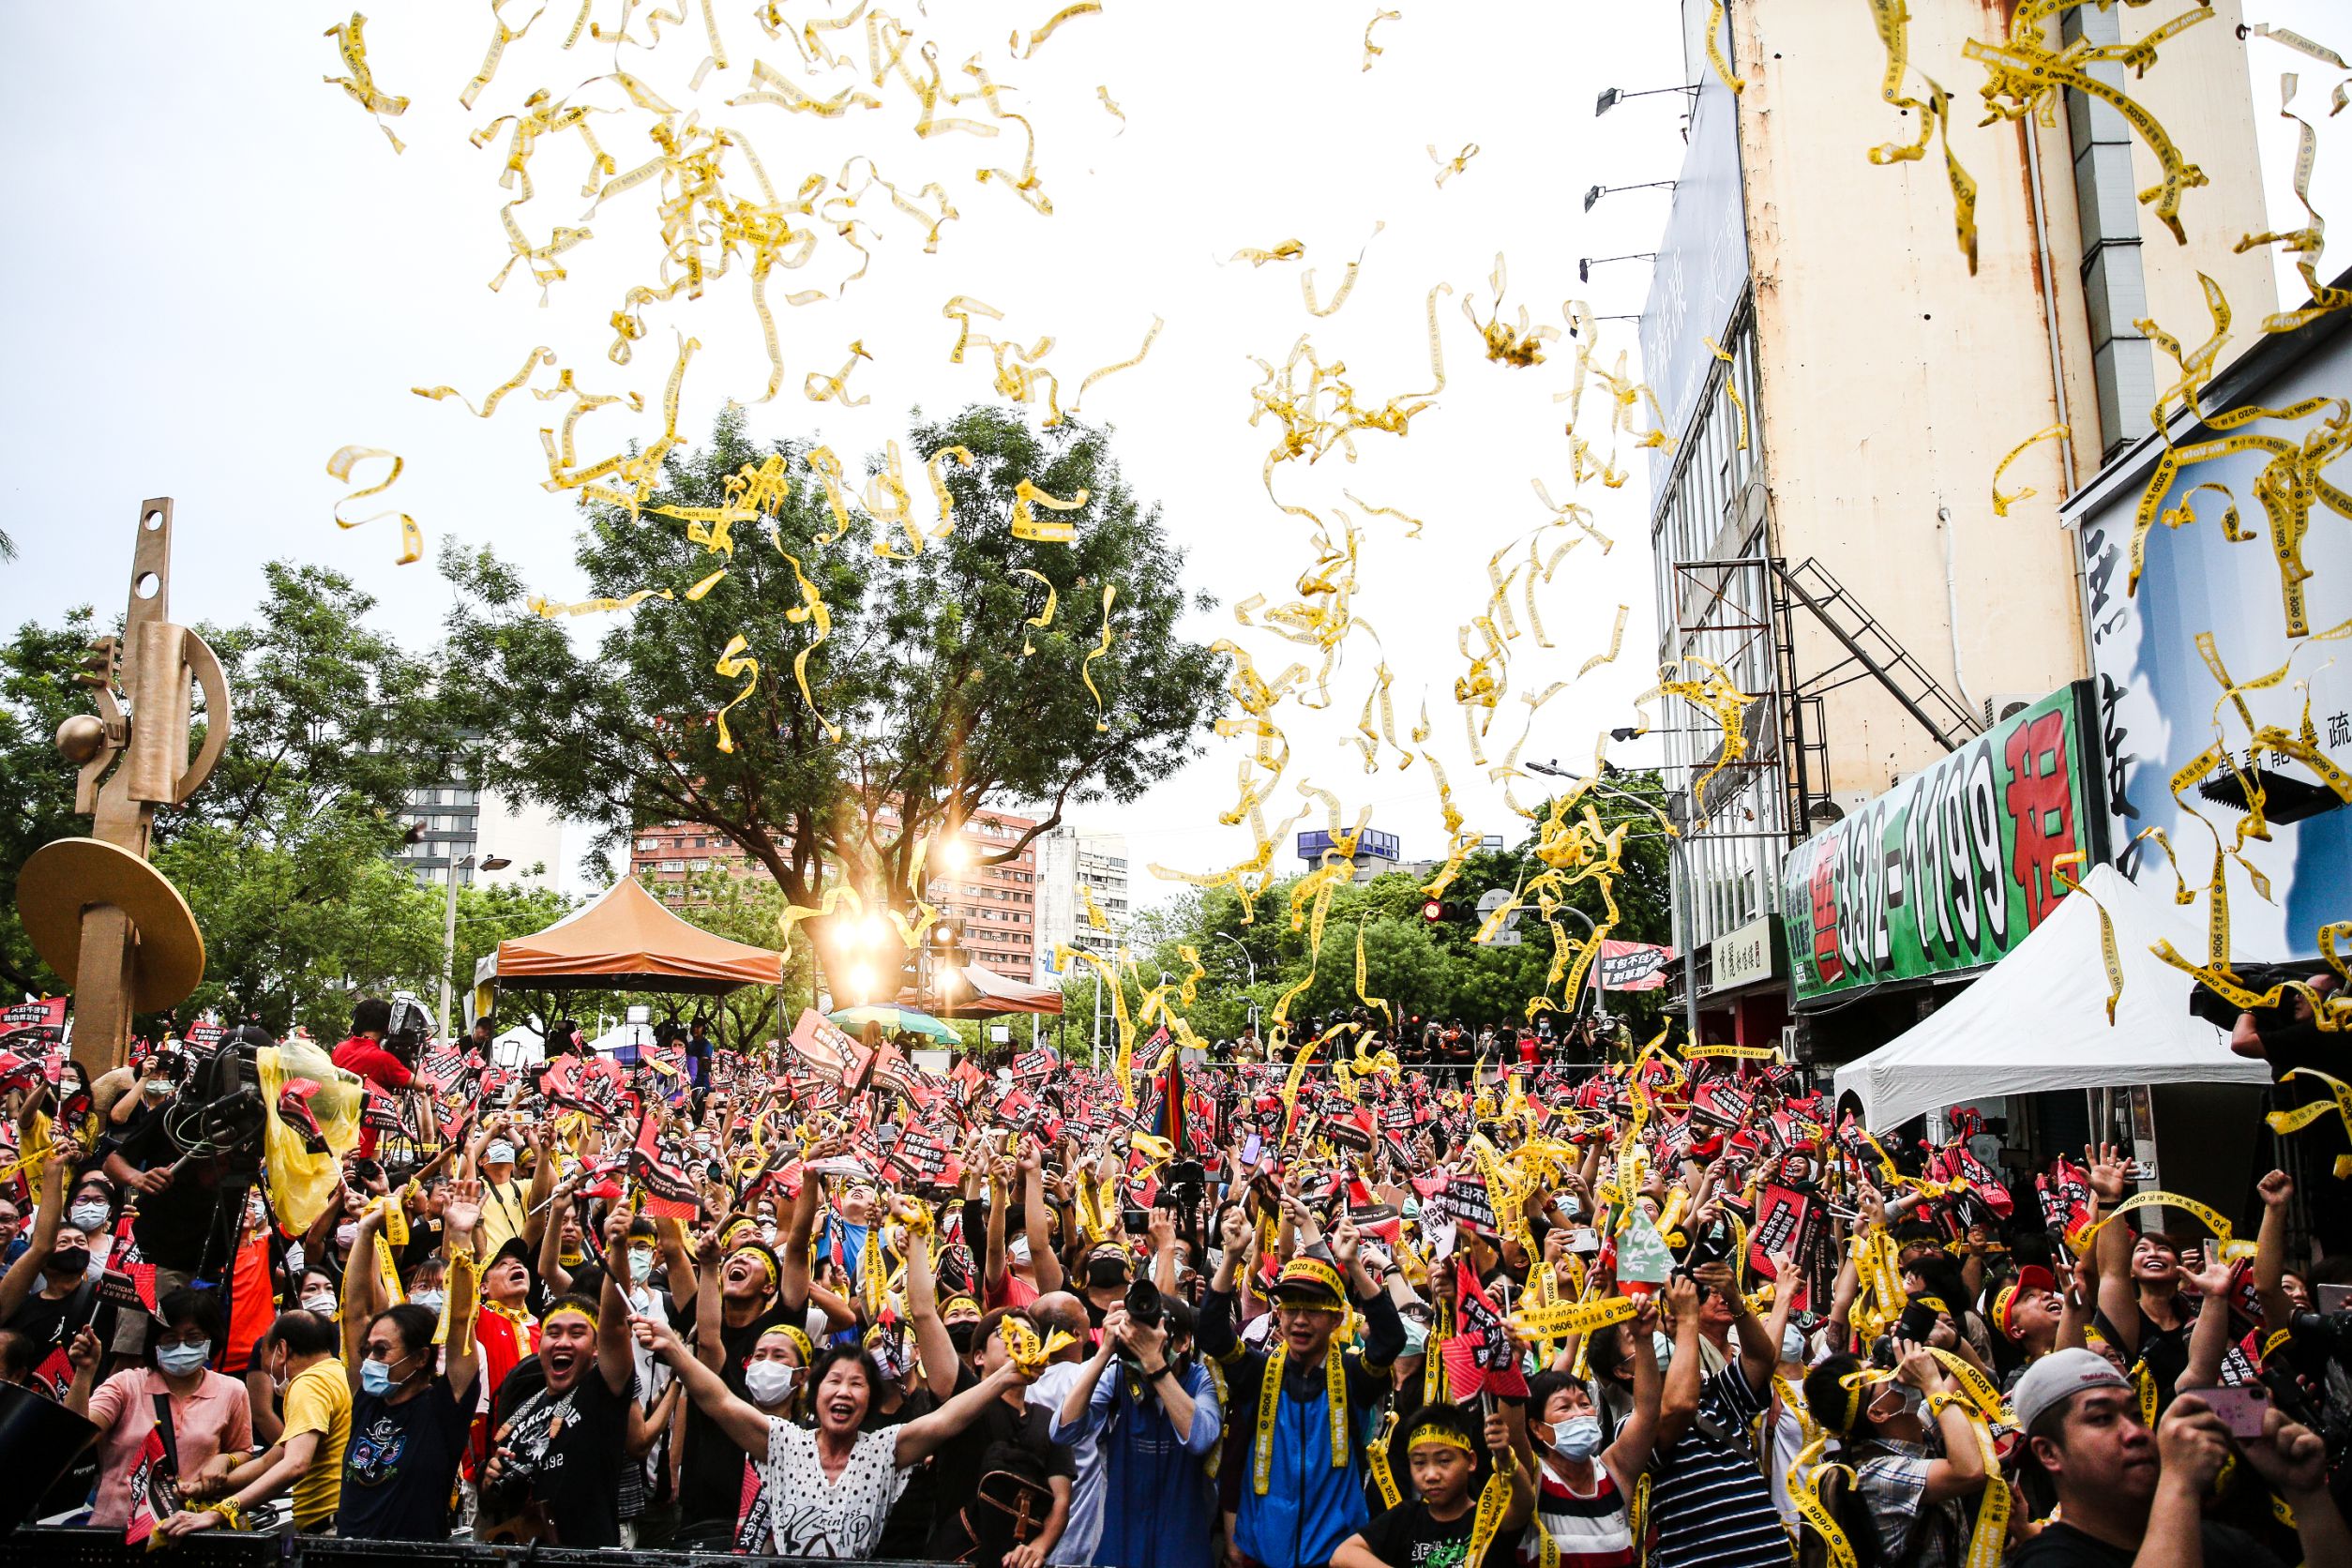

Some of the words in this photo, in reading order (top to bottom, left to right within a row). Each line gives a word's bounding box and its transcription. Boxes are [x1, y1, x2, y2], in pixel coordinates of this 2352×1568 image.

[747, 232, 764, 242] 2020
[2310, 755, 2331, 773] 0606
[1835, 738, 2008, 976] 332-1199
[2213, 933, 2223, 957] 0606
[1288, 1262, 1308, 1272] 2020
[1550, 1320, 1573, 1333] 0606
[1331, 1351, 1341, 1370] 0606
[1332, 1371, 1344, 1404] 天佑台灣
[2145, 1382, 2155, 1410] 0606
[1262, 1394, 1272, 1417] 0606
[1334, 1407, 1344, 1425] We
[1334, 1426, 1345, 1450] Vote
[1410, 1427, 1427, 1440] 2020
[1385, 1485, 1397, 1505] 2020
[1809, 1505, 1831, 1532] 0606
